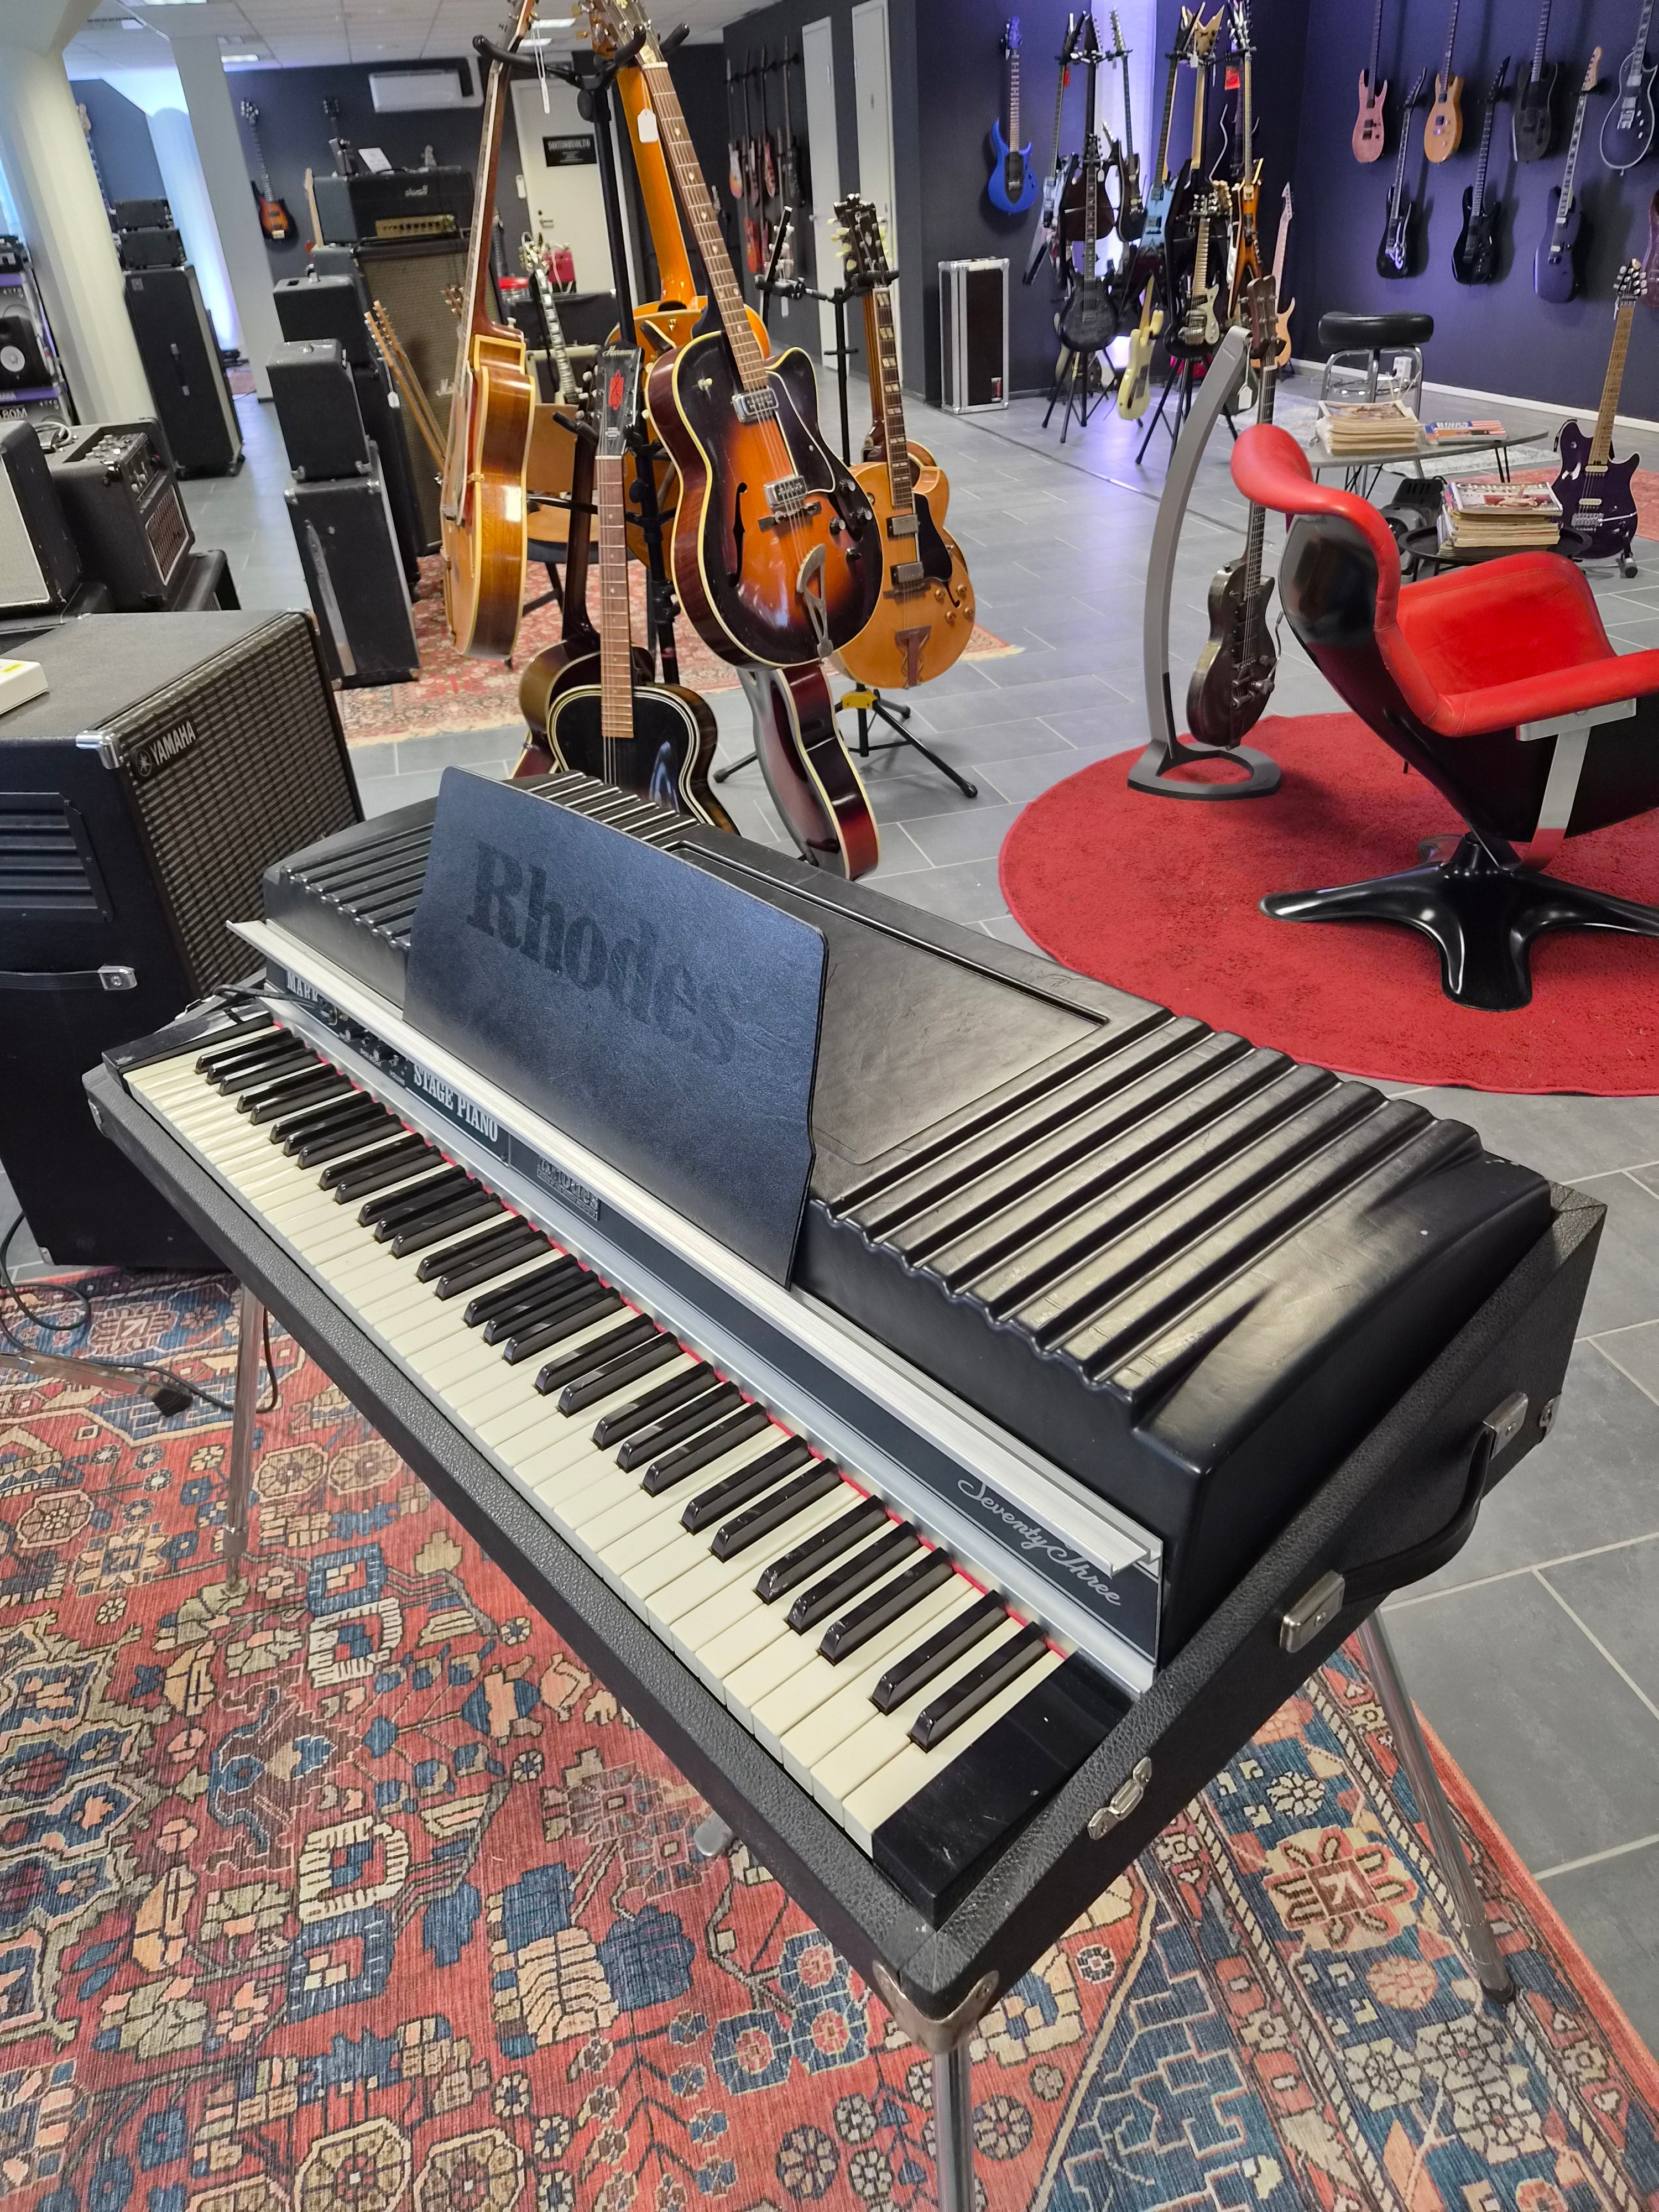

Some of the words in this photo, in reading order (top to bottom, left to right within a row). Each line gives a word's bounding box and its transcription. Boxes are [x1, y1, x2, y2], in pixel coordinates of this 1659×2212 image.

[601, 345, 637, 359] Harmony
[149, 721, 196, 766] YAMAHA
[466, 840, 737, 1065] Rhodes
[286, 971, 320, 1002] MARK
[414, 1063, 453, 1111] STAGE
[457, 1093, 498, 1142] PIANO
